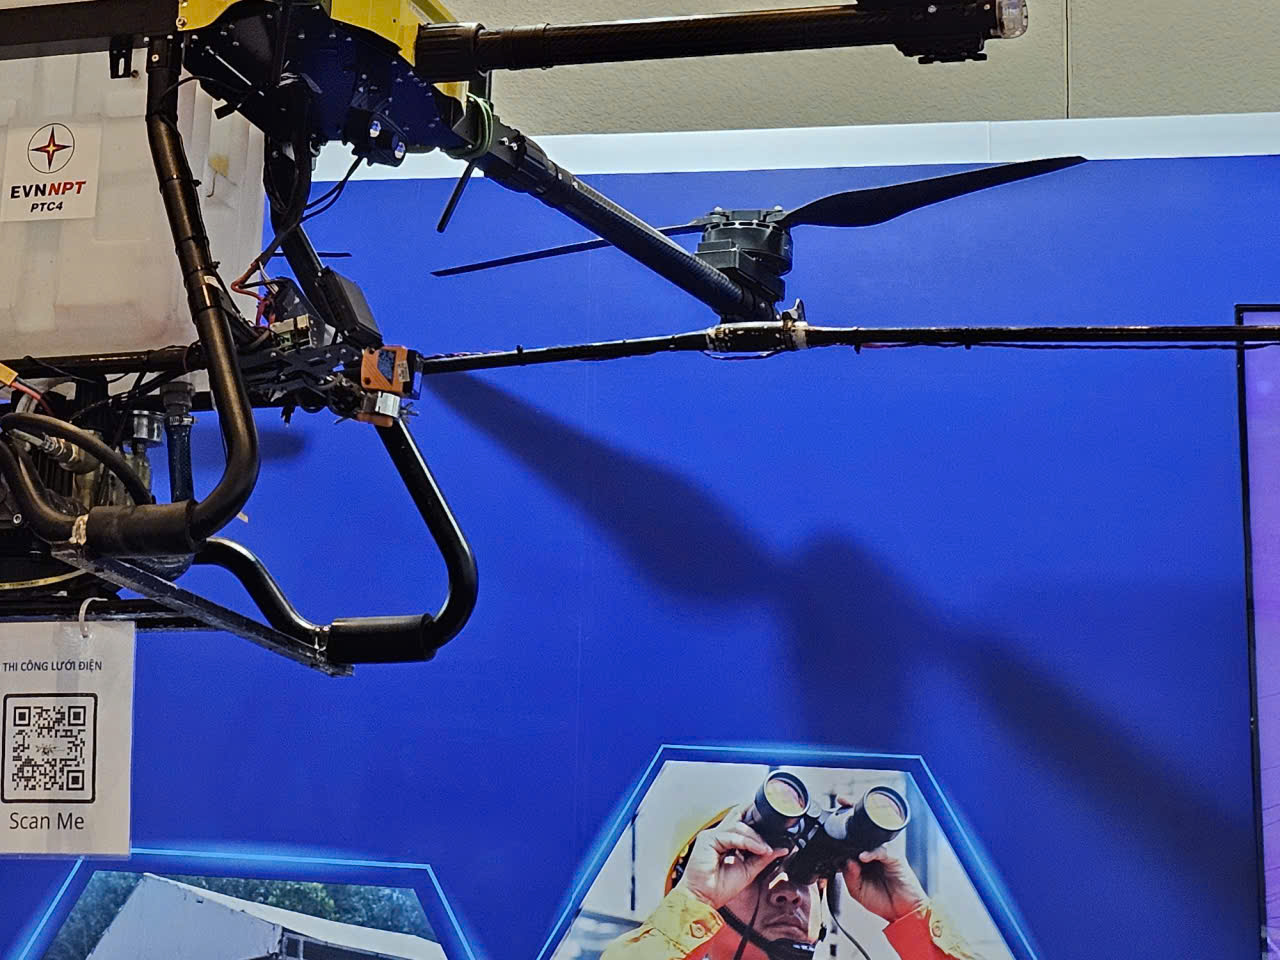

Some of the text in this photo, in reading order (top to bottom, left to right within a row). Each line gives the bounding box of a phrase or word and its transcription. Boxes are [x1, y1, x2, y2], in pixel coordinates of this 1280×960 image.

[30, 201, 64, 213] PTC4
[2, 661, 18, 672] THI
[20, 659, 49, 672] CÔNG
[51, 658, 76, 671] LƯỚI
[78, 658, 102, 673] ĐIỆN
[9, 812, 85, 830] Scan Me
